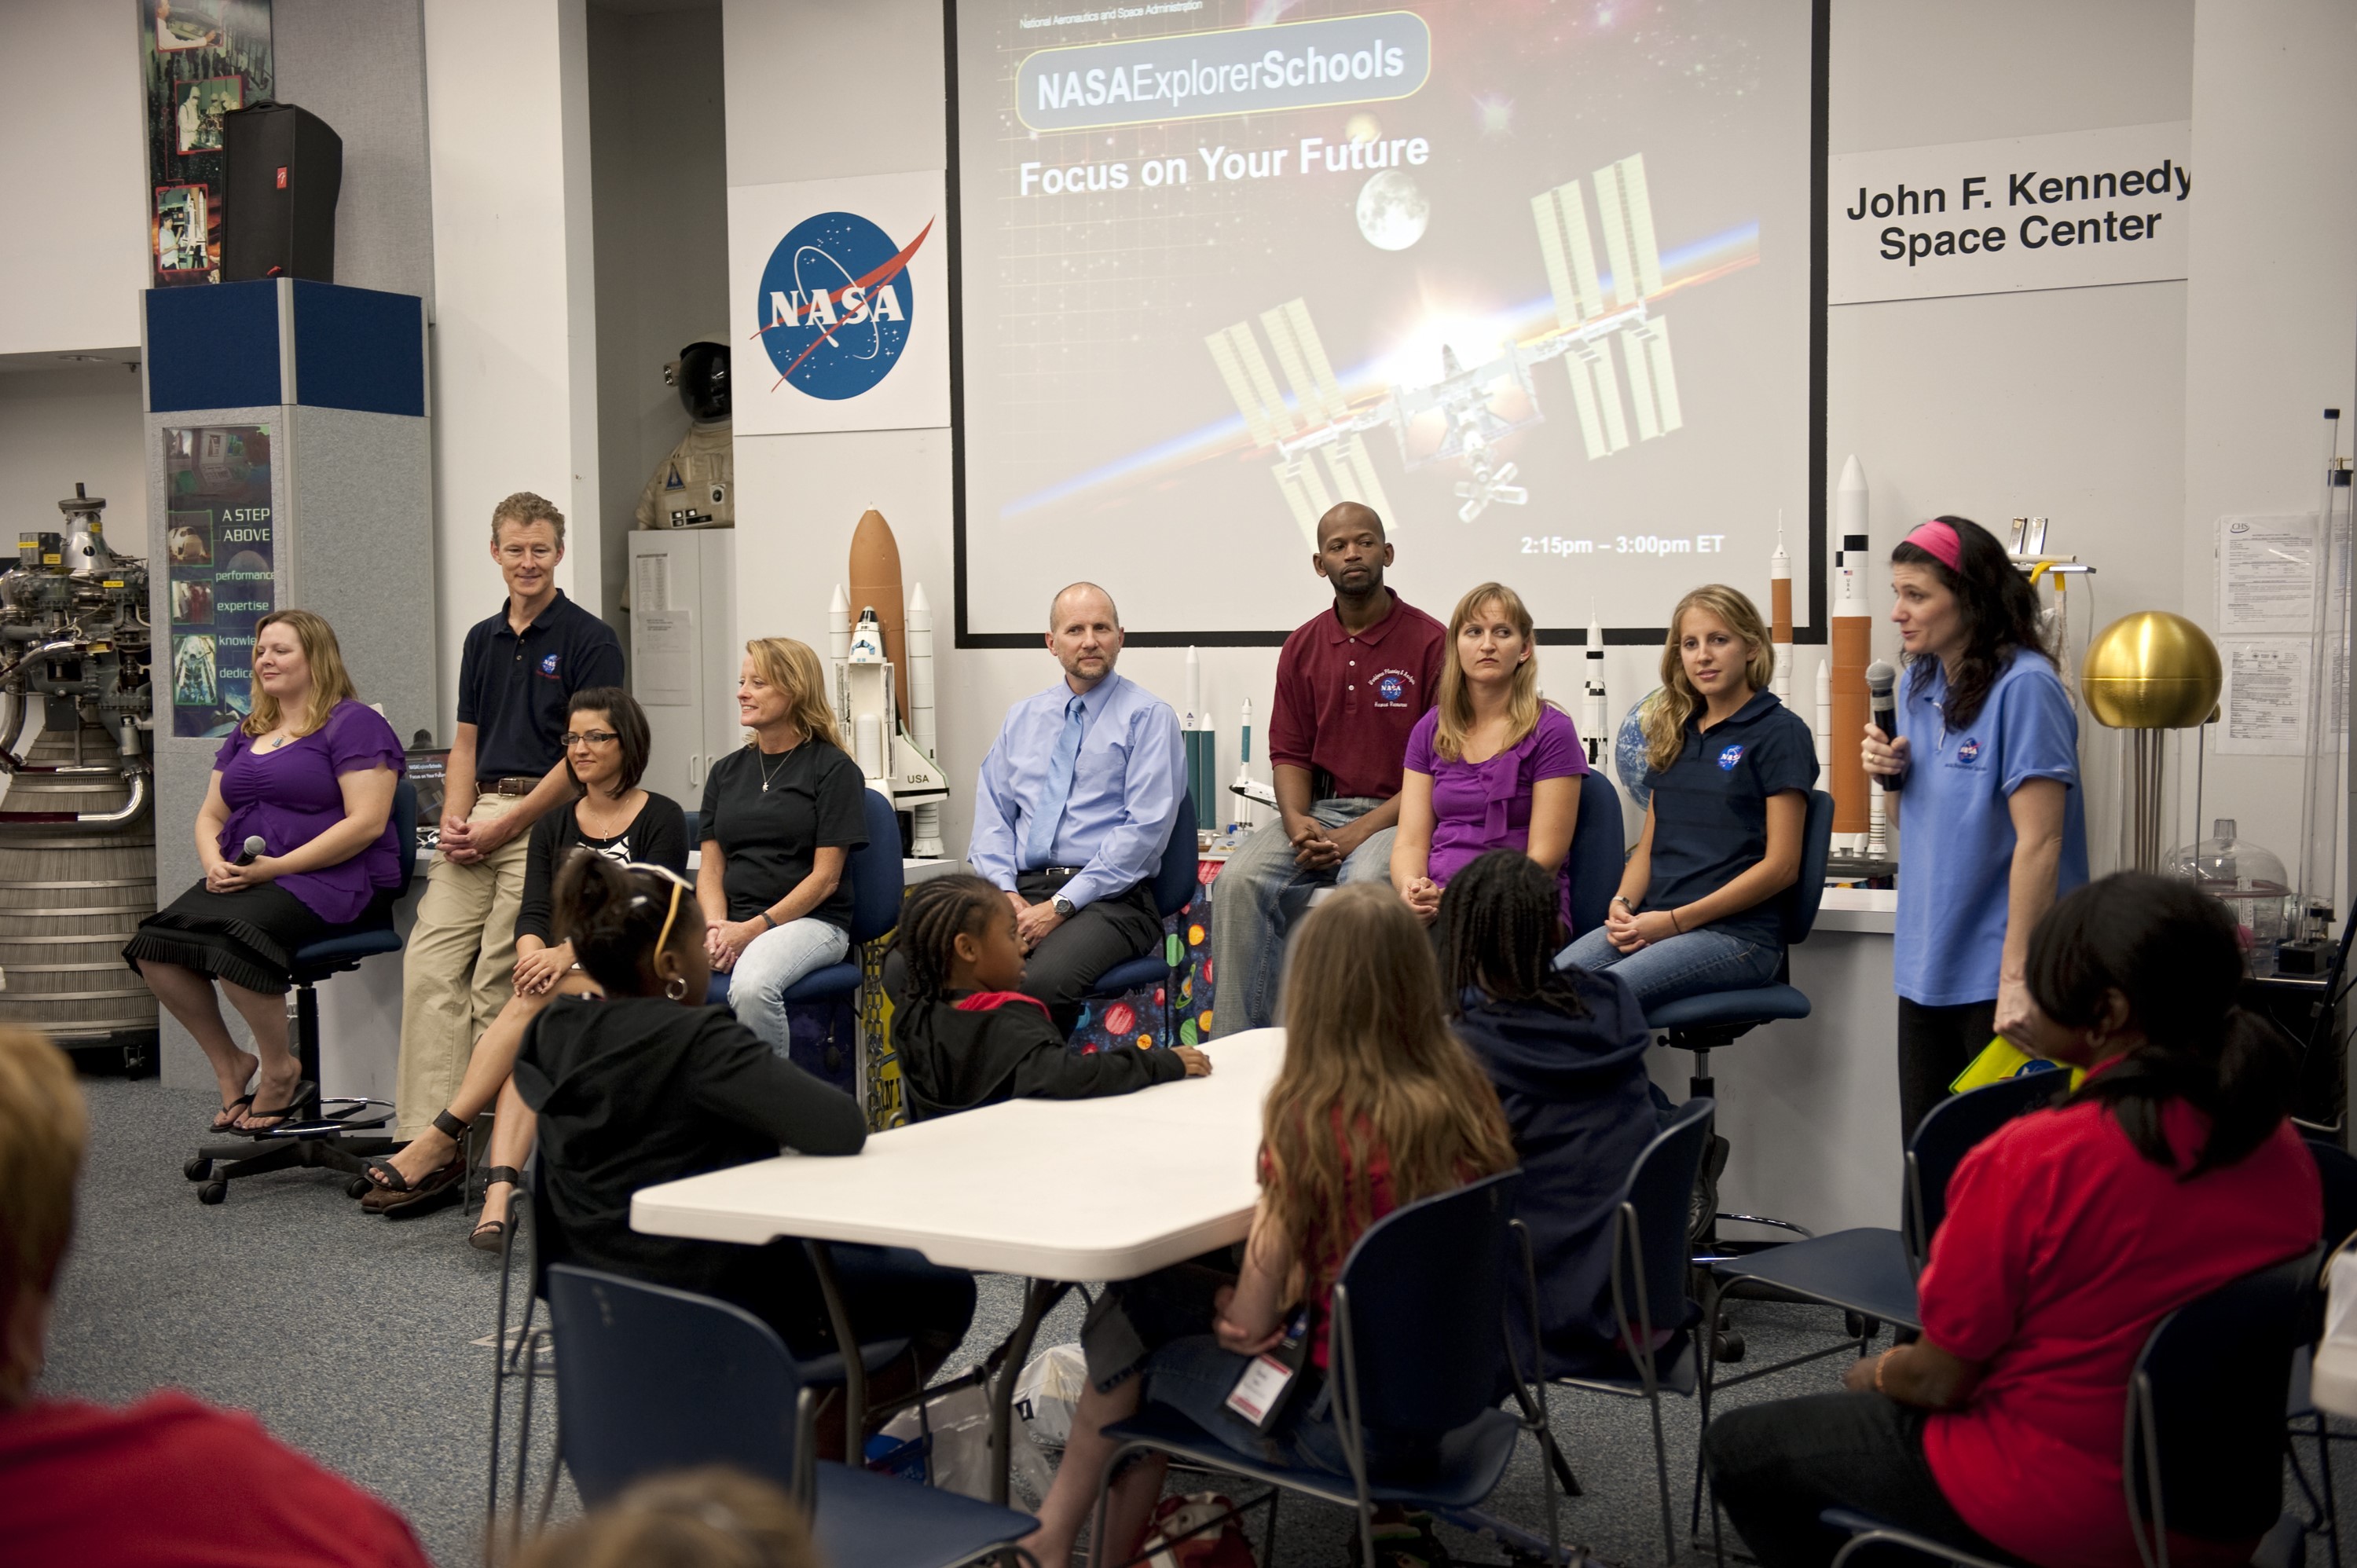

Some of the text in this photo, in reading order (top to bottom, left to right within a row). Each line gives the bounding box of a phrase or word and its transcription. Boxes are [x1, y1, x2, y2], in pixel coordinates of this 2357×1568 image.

[1020, 1, 1203, 29] National Aeronautics and Space Administration
[1038, 39, 1405, 110] NASAExplorerSchools
[1021, 137, 1429, 196] Focus on Your Future
[1847, 159, 2190, 220] John F. Kennedy
[1880, 211, 2162, 266] Space Center
[770, 284, 905, 328] NASA
[222, 508, 270, 522] A STEP
[223, 529, 270, 541] ABOVE
[1521, 537, 1593, 558] 2:15pm
[1616, 536, 1690, 557] 3:00pm
[1697, 535, 1725, 552] ET
[215, 570, 275, 582] performance
[217, 601, 269, 613] expertise
[219, 636, 257, 646] knowle
[220, 668, 254, 678] dedica
[907, 775, 929, 783] USA
